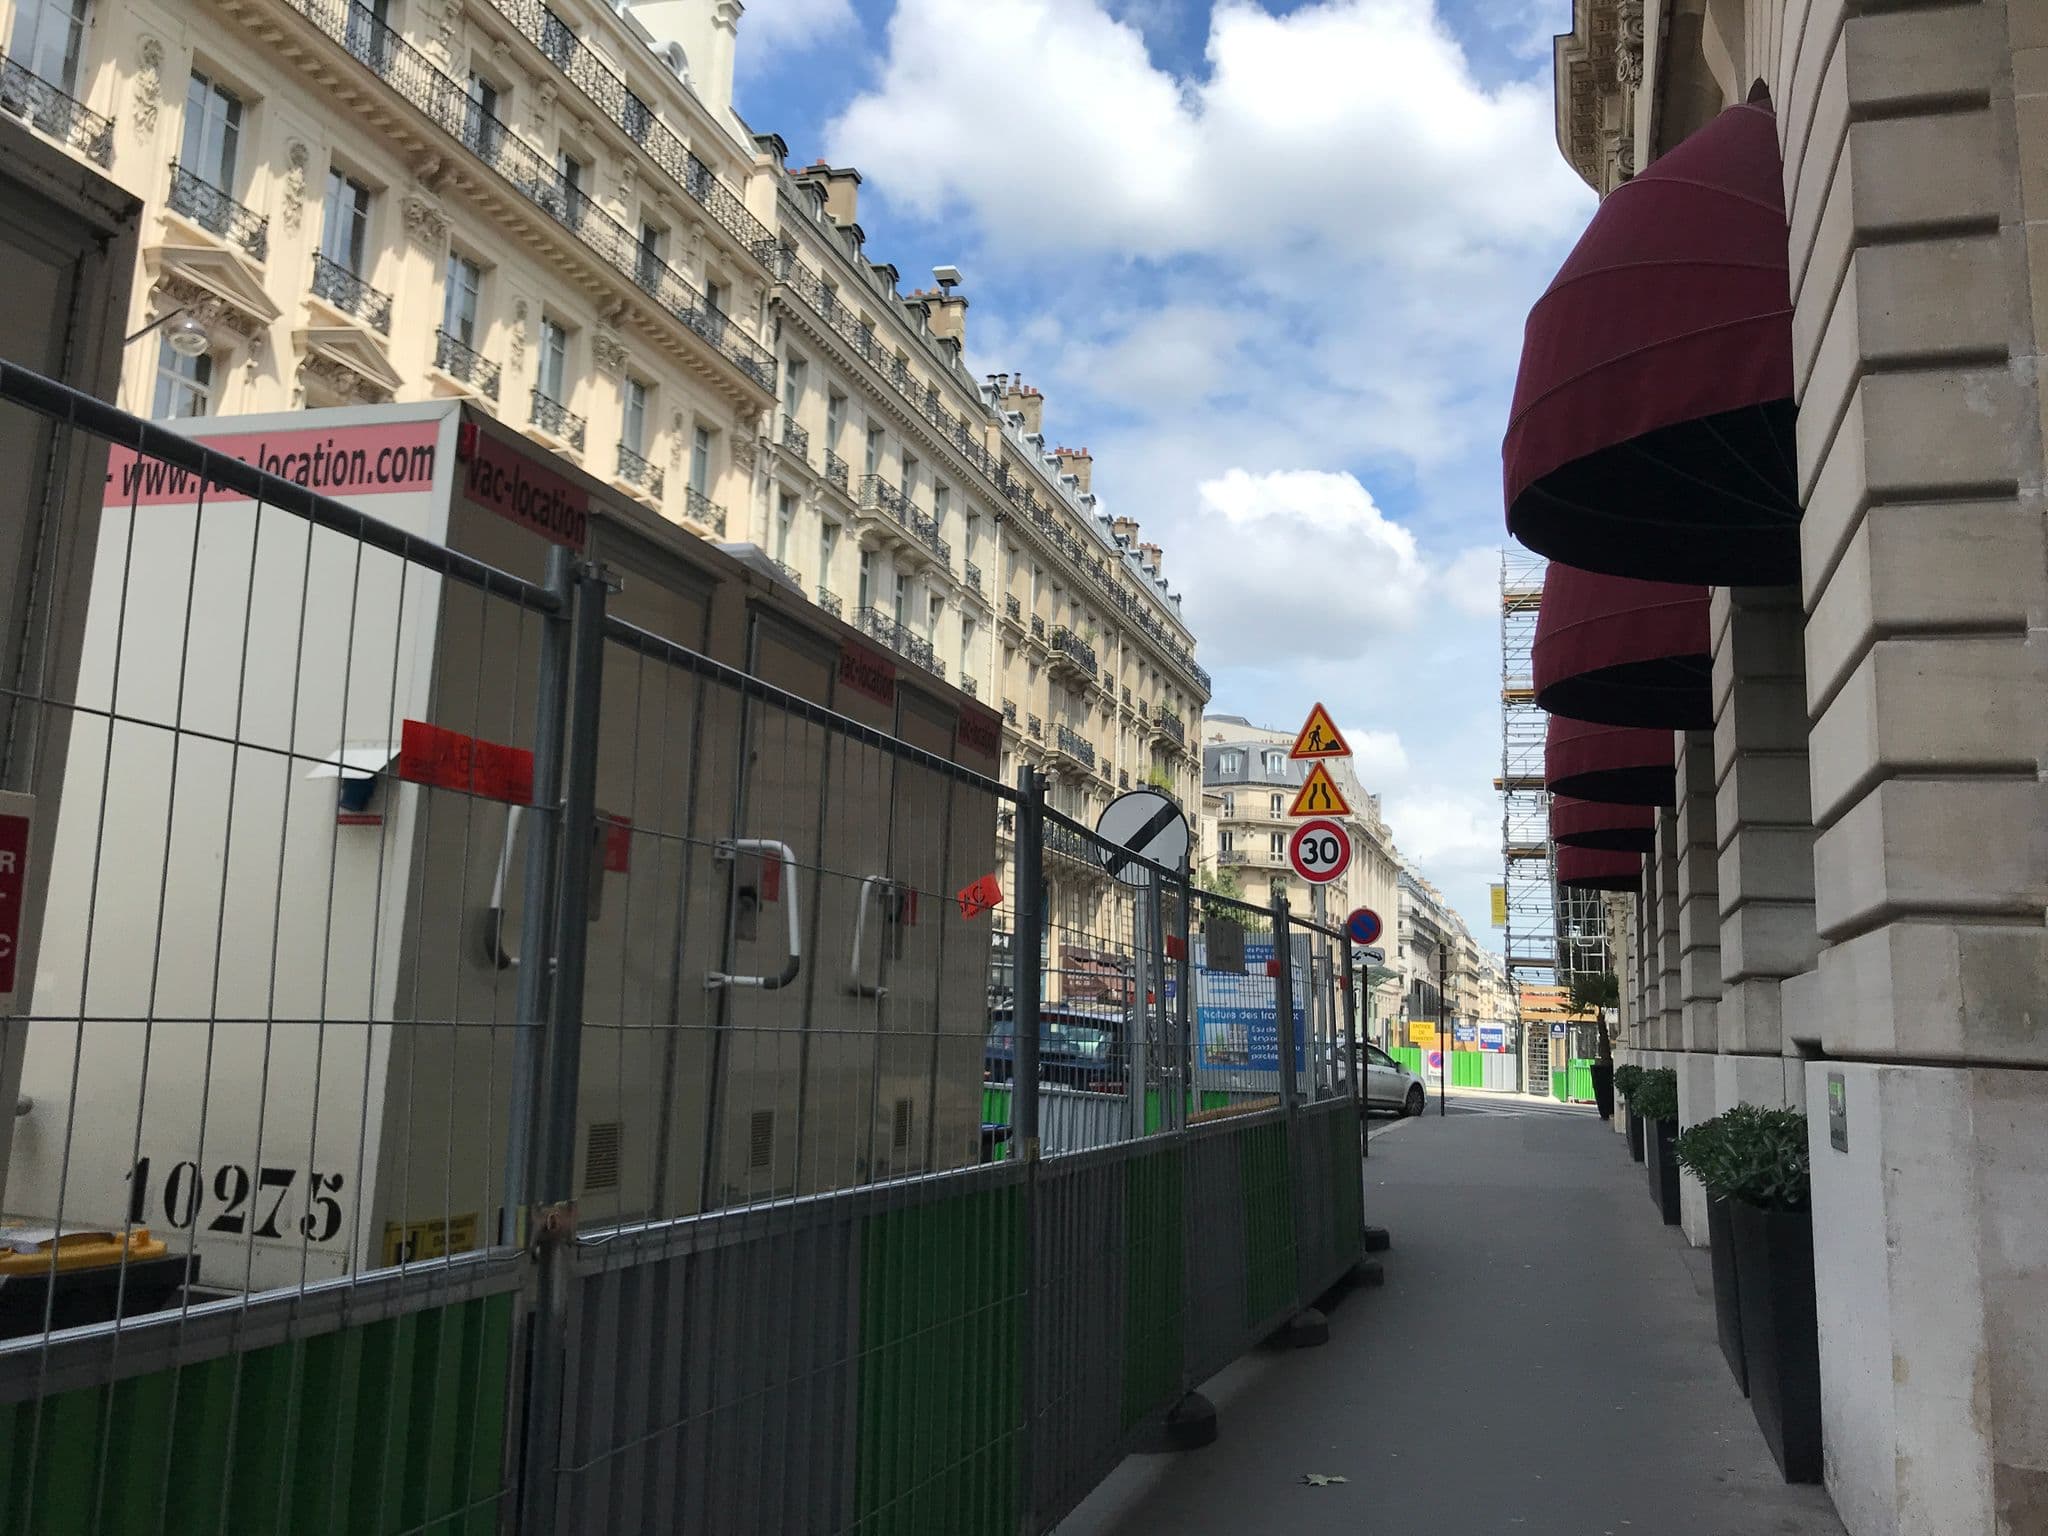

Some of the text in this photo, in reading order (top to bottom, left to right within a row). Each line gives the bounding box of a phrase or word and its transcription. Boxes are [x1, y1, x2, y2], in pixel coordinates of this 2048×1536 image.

[1302, 837, 1339, 865] 30
[1203, 1009, 1236, 1021] Nature
[1240, 1009, 1258, 1021] des
[125, 1156, 343, 1242] 10275
